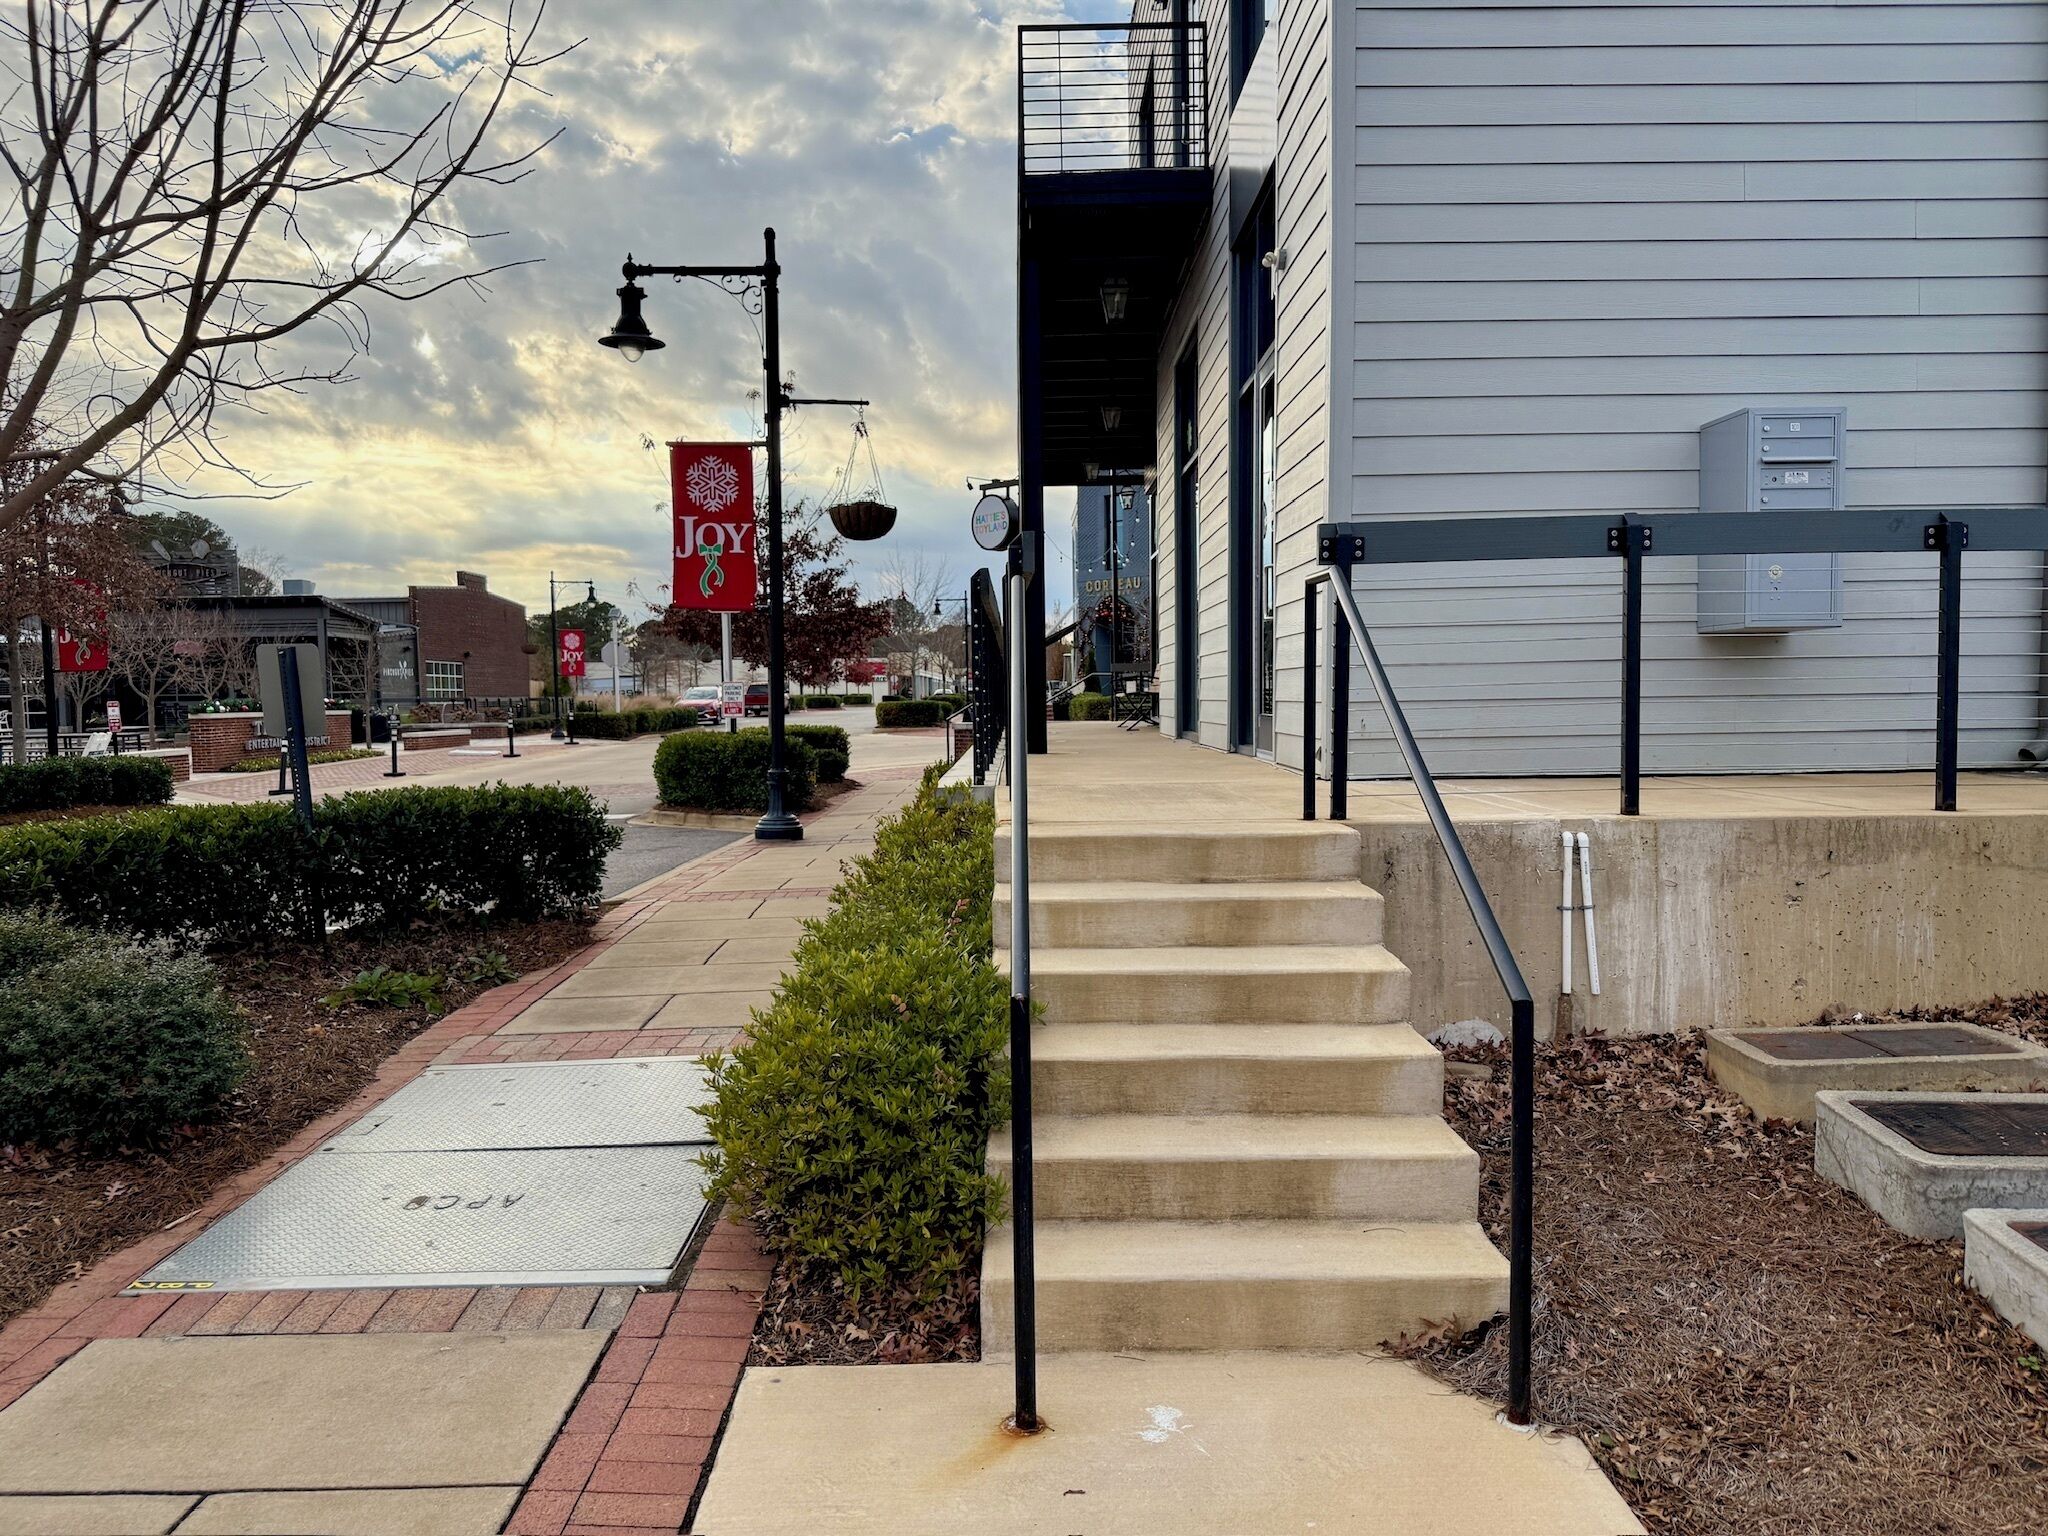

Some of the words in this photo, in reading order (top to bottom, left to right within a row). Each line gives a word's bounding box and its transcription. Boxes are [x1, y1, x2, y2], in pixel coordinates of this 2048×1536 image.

[975, 520, 1008, 535] TOYLAND
[675, 515, 753, 559] JOY
[196, 566, 216, 577] PIES
[1085, 576, 1141, 593] COREAU
[561, 649, 584, 662] JOY
